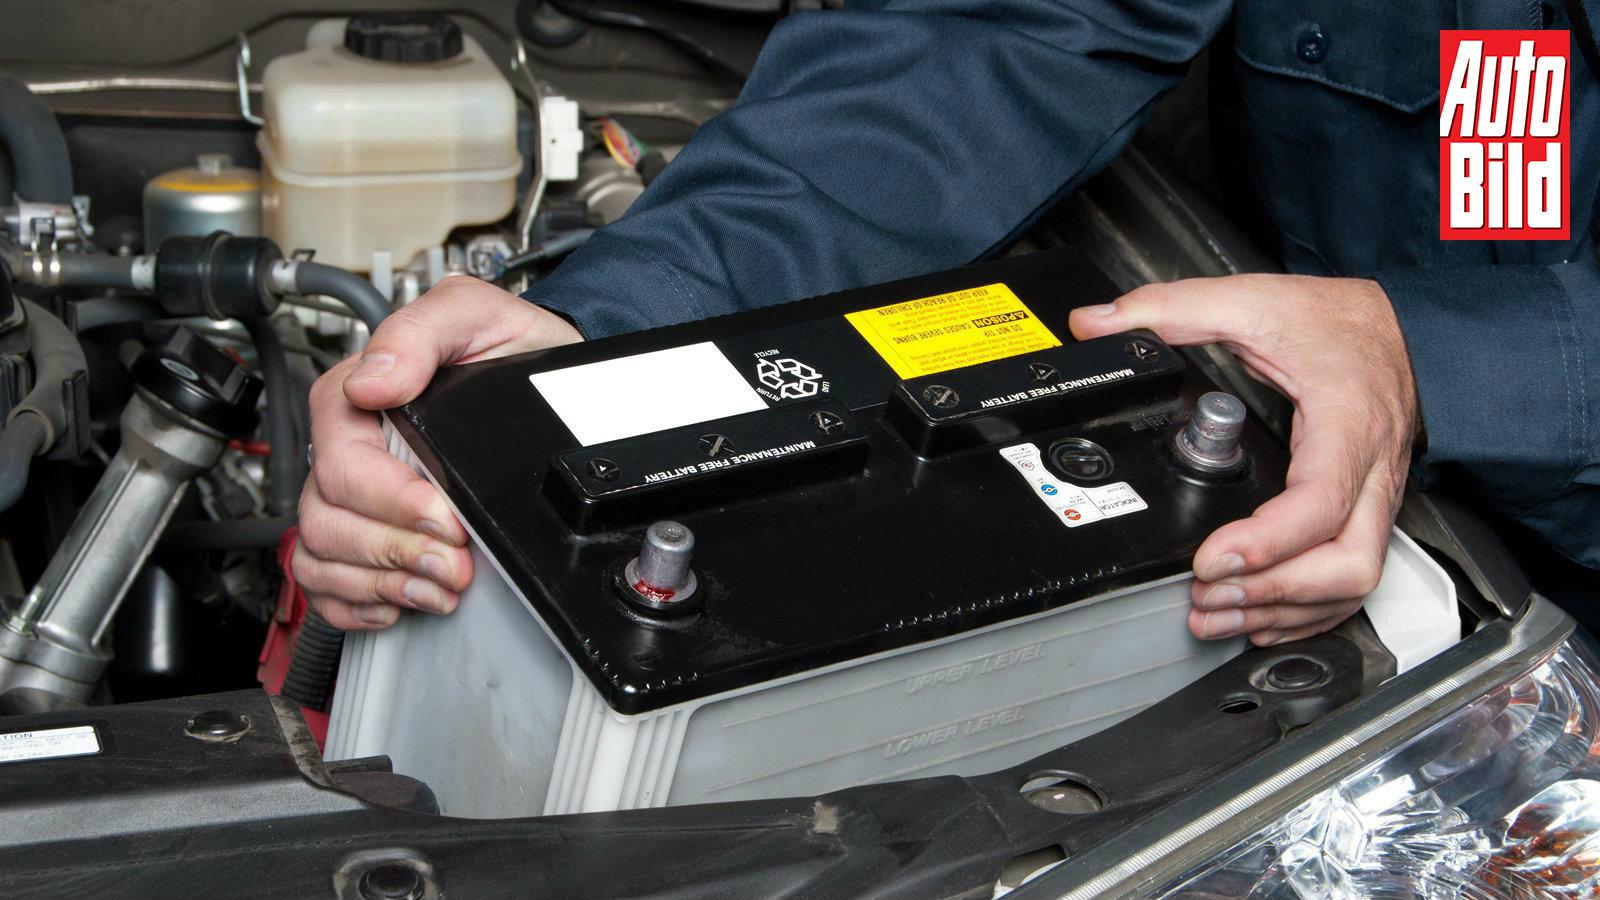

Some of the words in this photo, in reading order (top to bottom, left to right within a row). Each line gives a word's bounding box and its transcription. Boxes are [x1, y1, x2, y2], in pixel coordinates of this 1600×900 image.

[958, 291, 969, 301] OUT
[972, 289, 989, 298] KEEP
[923, 296, 946, 308] REACH
[878, 303, 913, 317] CHILDREN
[975, 312, 1017, 328] POISON
[920, 326, 944, 340] SEVERE
[948, 322, 972, 335] CAUSES
[983, 328, 996, 337] TIP
[997, 326, 1010, 336] NOT
[1010, 324, 1023, 333] DO
[893, 332, 918, 345] BURNS
[753, 348, 780, 359] RECYCLE
[1057, 368, 1135, 391] MAINTENANCE
[755, 387, 781, 402] RETURN
[1028, 385, 1058, 398] FREE
[980, 392, 1028, 408] BATTERY
[730, 440, 816, 464] MAINTENANCE
[698, 458, 731, 472] FREE
[644, 465, 698, 484] BATTERY
[1100, 498, 1138, 511] INDICATOR
[905, 662, 974, 696] UPPER
[980, 643, 1046, 676] LEVEL
[0, 732, 33, 740] TION
[883, 724, 960, 759] LOWER
[964, 707, 1025, 738] LEVEL
